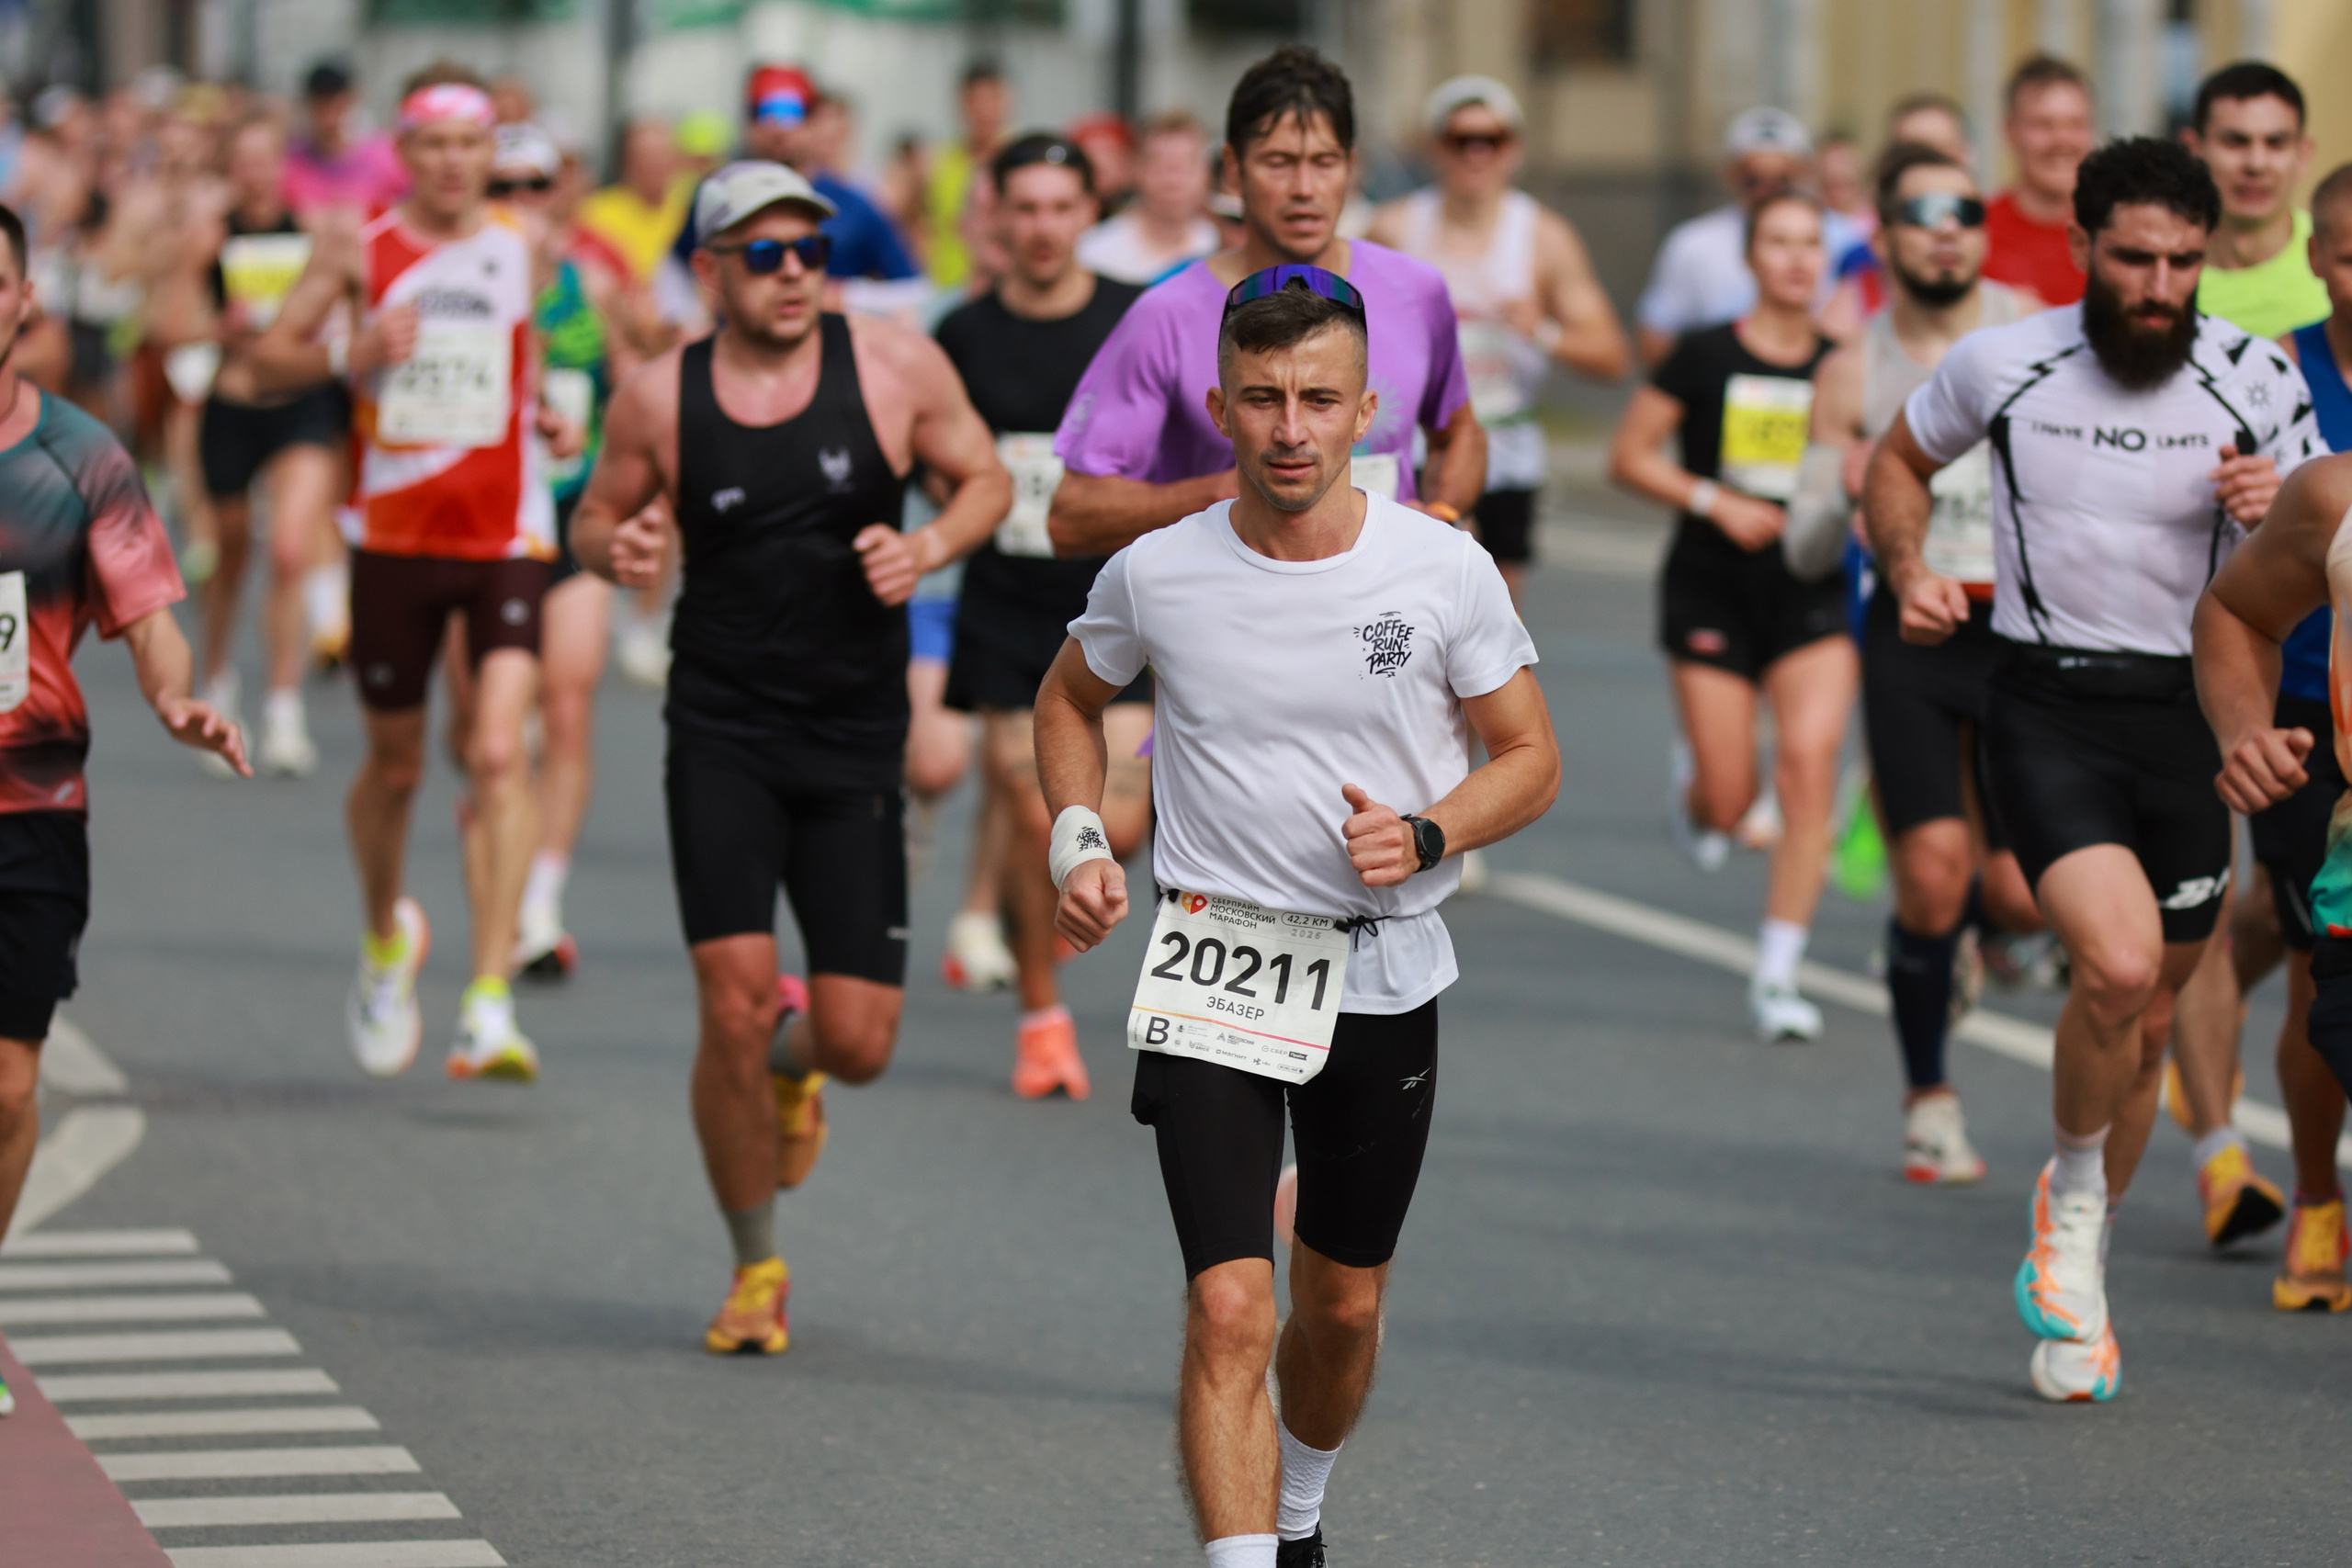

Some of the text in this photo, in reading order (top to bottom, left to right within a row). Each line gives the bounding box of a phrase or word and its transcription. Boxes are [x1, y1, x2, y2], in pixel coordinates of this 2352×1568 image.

[2093, 424, 2147, 452] NO
[1363, 619, 1415, 642] COFFEE
[1372, 637, 1403, 652] RUN
[1365, 651, 1412, 674] PARTY
[1210, 904, 1276, 924] МОСКОВСКИЙ
[1212, 897, 1260, 912] СБЕРПРАЙМ
[1209, 912, 1257, 930] МАРАФОН
[1286, 915, 1329, 927] 42,2 КМ
[1290, 929, 1322, 940] 2026
[1150, 931, 1330, 1010] 20211
[1206, 996, 1265, 1021] ЭБАЗЕР
